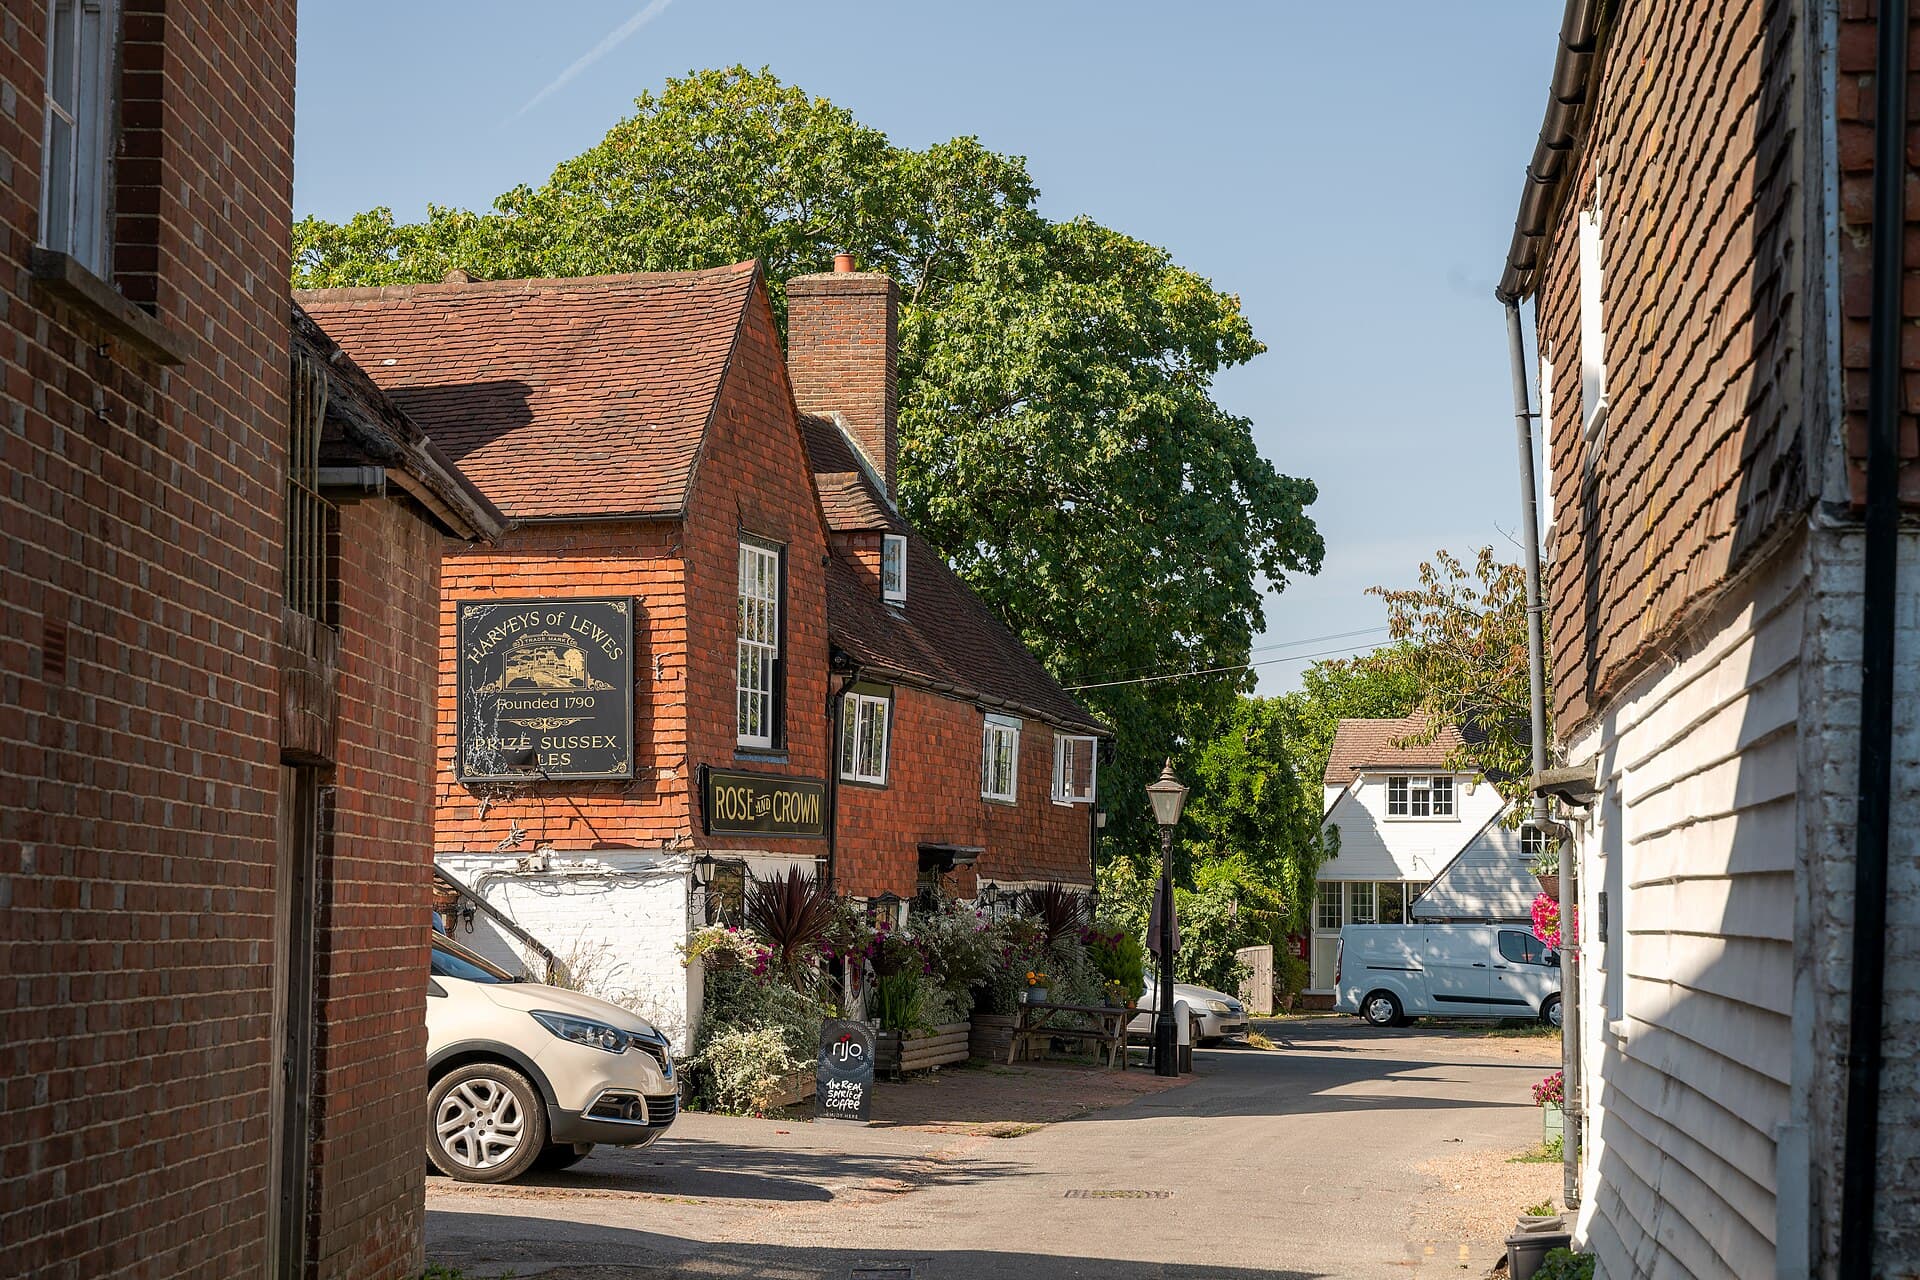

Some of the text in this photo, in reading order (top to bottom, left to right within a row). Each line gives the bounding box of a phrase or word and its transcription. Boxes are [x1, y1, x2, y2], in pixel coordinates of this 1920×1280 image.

[467, 611, 624, 664] HARVEYS of LEWES
[525, 636, 546, 644] TRADE
[497, 696, 595, 710] Founded 1790
[540, 735, 617, 749] SUSSEX
[537, 753, 571, 766] LES
[715, 786, 820, 825] ROSE AND CROWN
